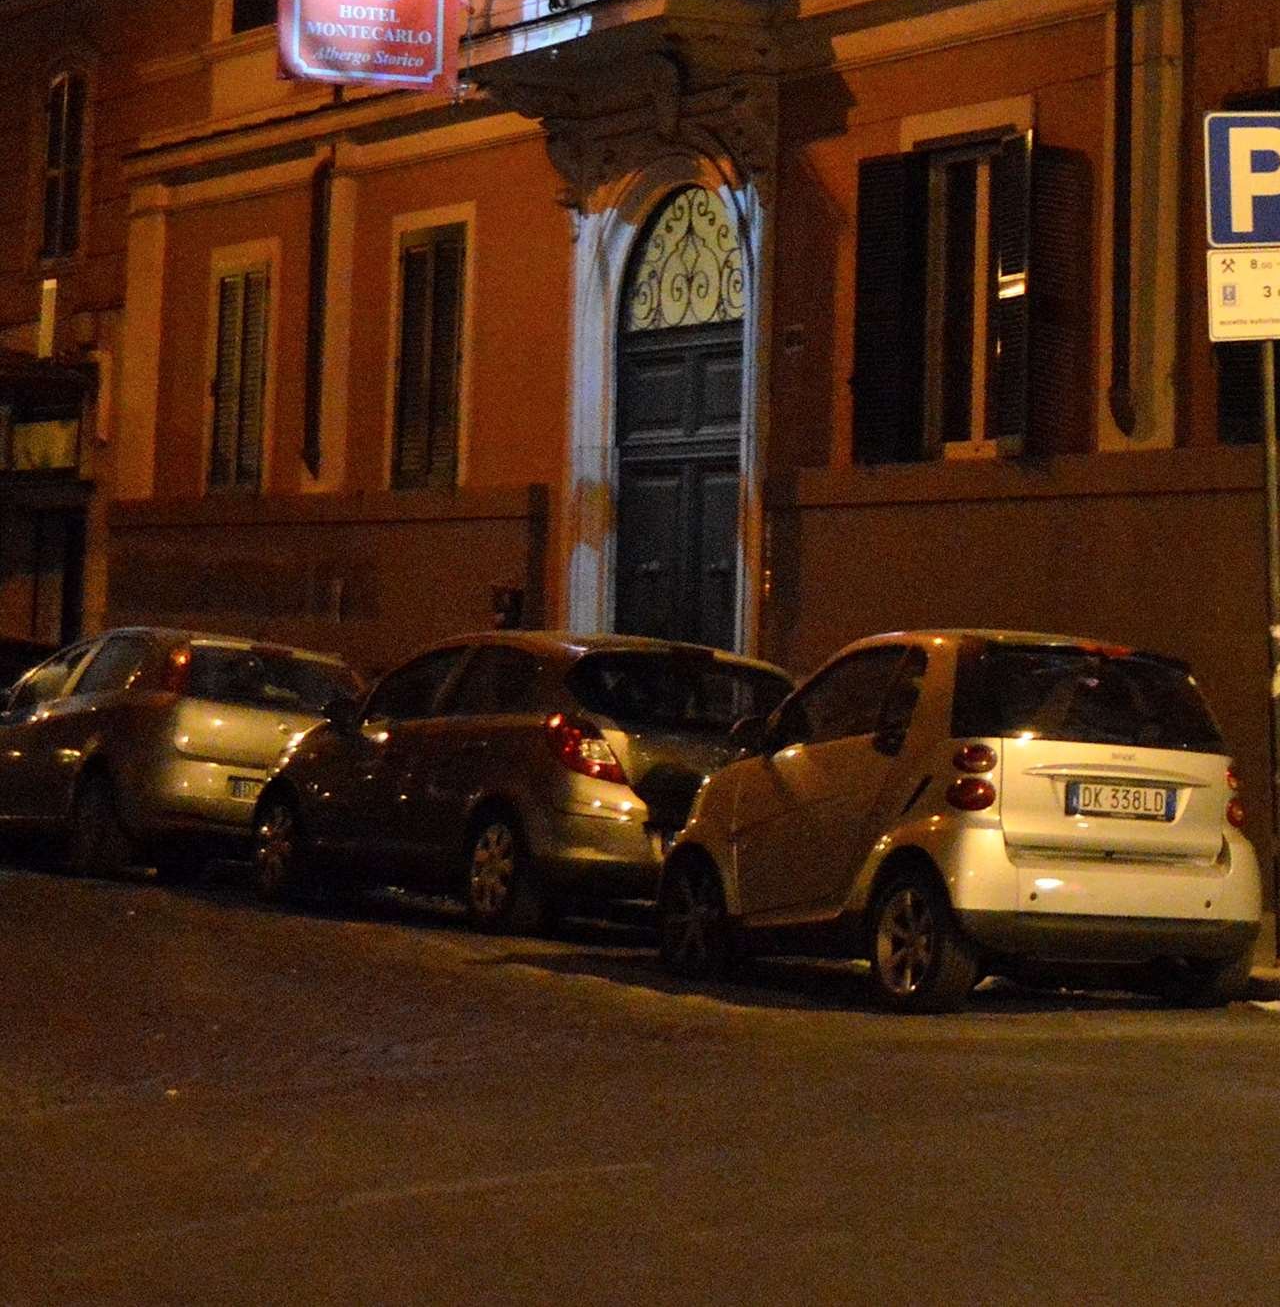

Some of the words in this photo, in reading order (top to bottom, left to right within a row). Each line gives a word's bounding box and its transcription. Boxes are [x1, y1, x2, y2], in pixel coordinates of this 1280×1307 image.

[338, 4, 400, 23] HOTEL
[305, 21, 432, 45] MONTECARLO
[313, 45, 370, 66] Albergo
[374, 50, 424, 67] Storico
[1263, 285, 1272, 298] 3
[1082, 786, 1103, 808] DK
